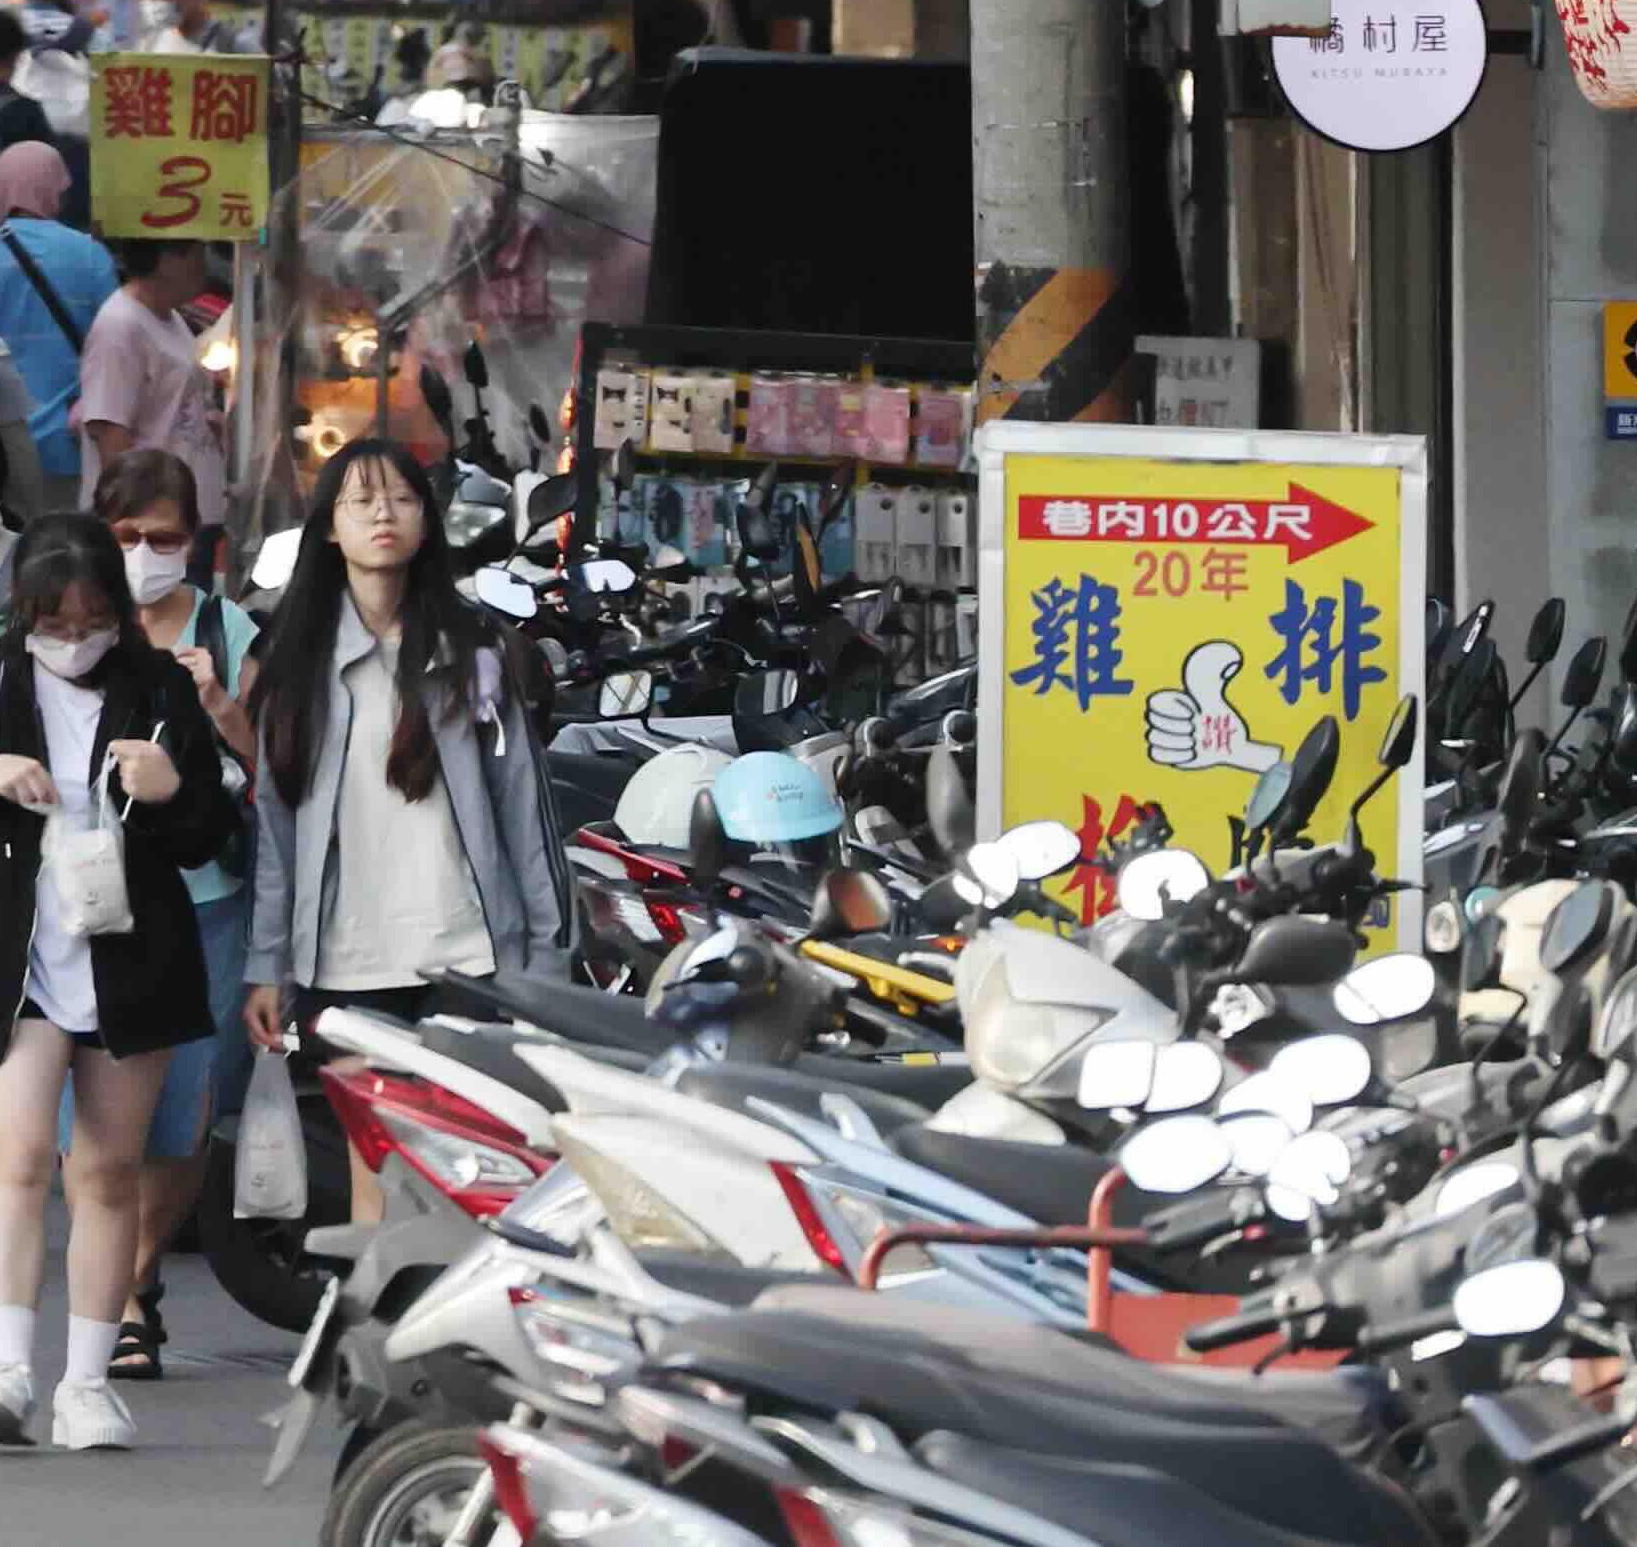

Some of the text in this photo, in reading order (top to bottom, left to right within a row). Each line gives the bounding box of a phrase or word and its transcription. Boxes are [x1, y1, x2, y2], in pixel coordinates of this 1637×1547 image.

[103, 65, 258, 143] 雞腳
[1042, 500, 1313, 541] 巷內10公尺
[1132, 548, 1250, 602] 20年
[1009, 572, 1388, 722] 雞排
